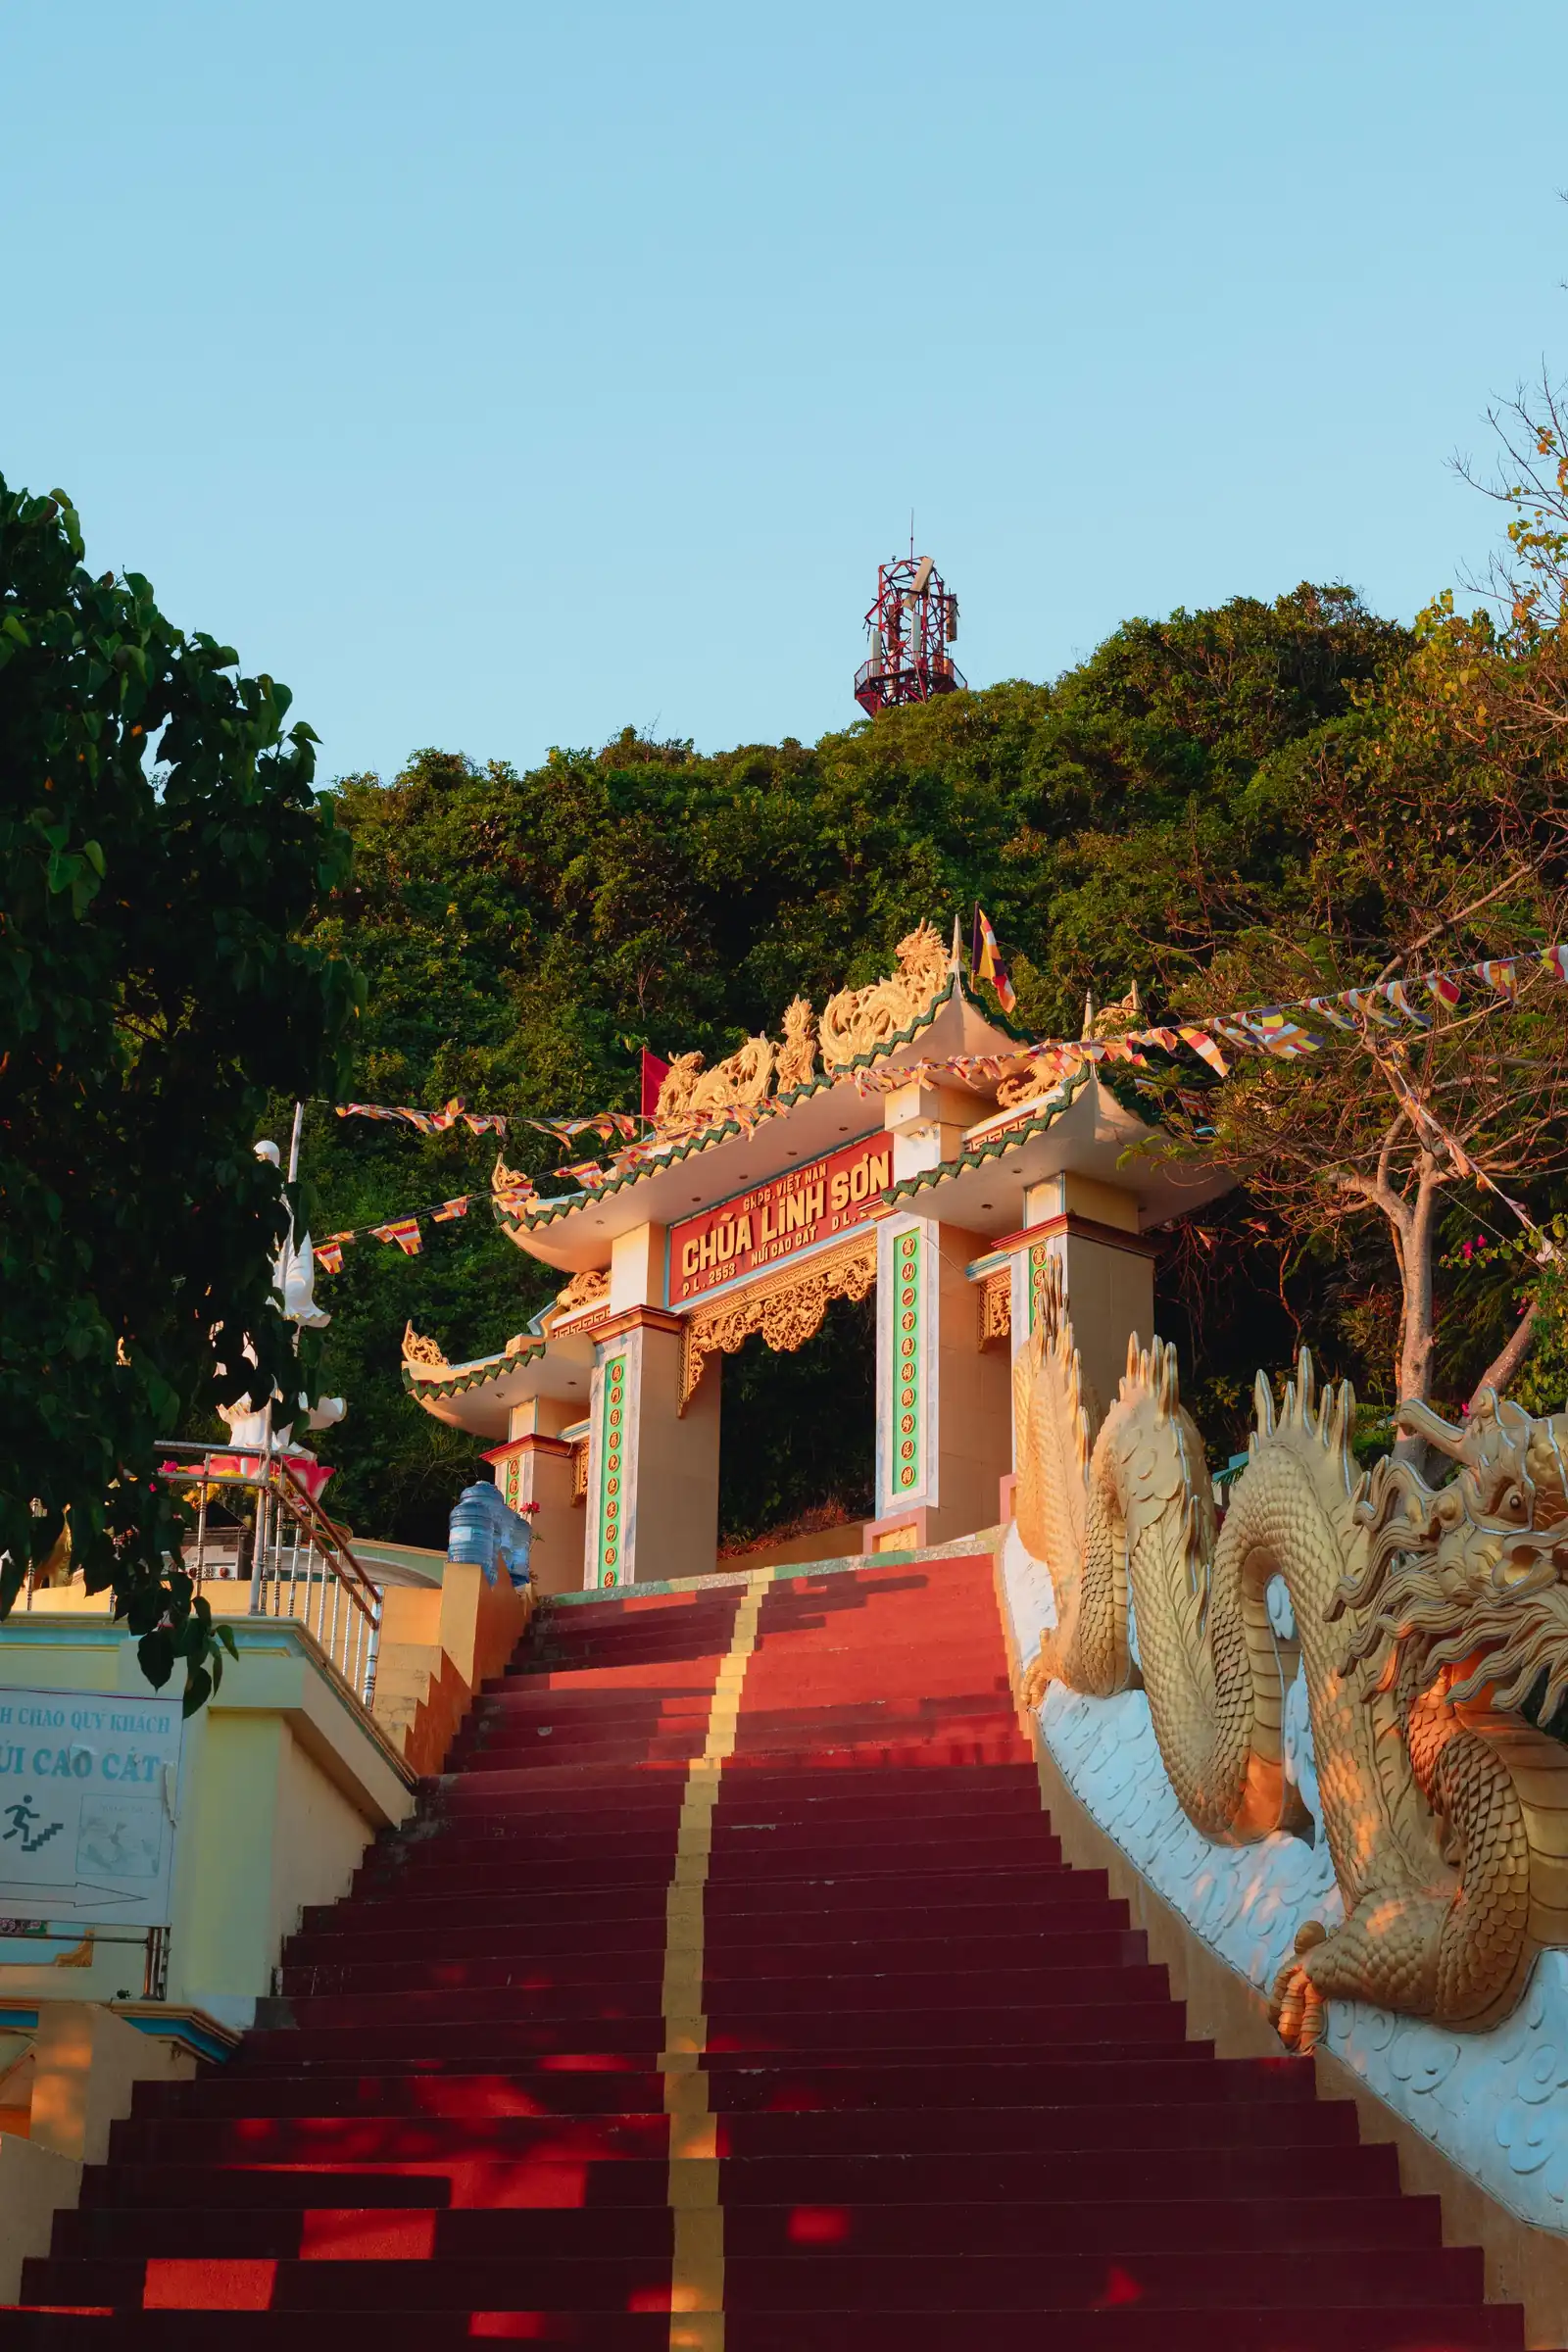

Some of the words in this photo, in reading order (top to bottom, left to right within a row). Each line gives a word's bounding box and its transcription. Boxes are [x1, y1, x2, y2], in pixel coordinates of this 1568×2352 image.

[805, 1162, 827, 1185] NAM
[831, 1151, 889, 1211] SƠN
[709, 1261, 736, 1285] 2553
[771, 1237, 792, 1257] CAO
[795, 1223, 817, 1247] CÁT
[32, 1745, 93, 1779] CAO
